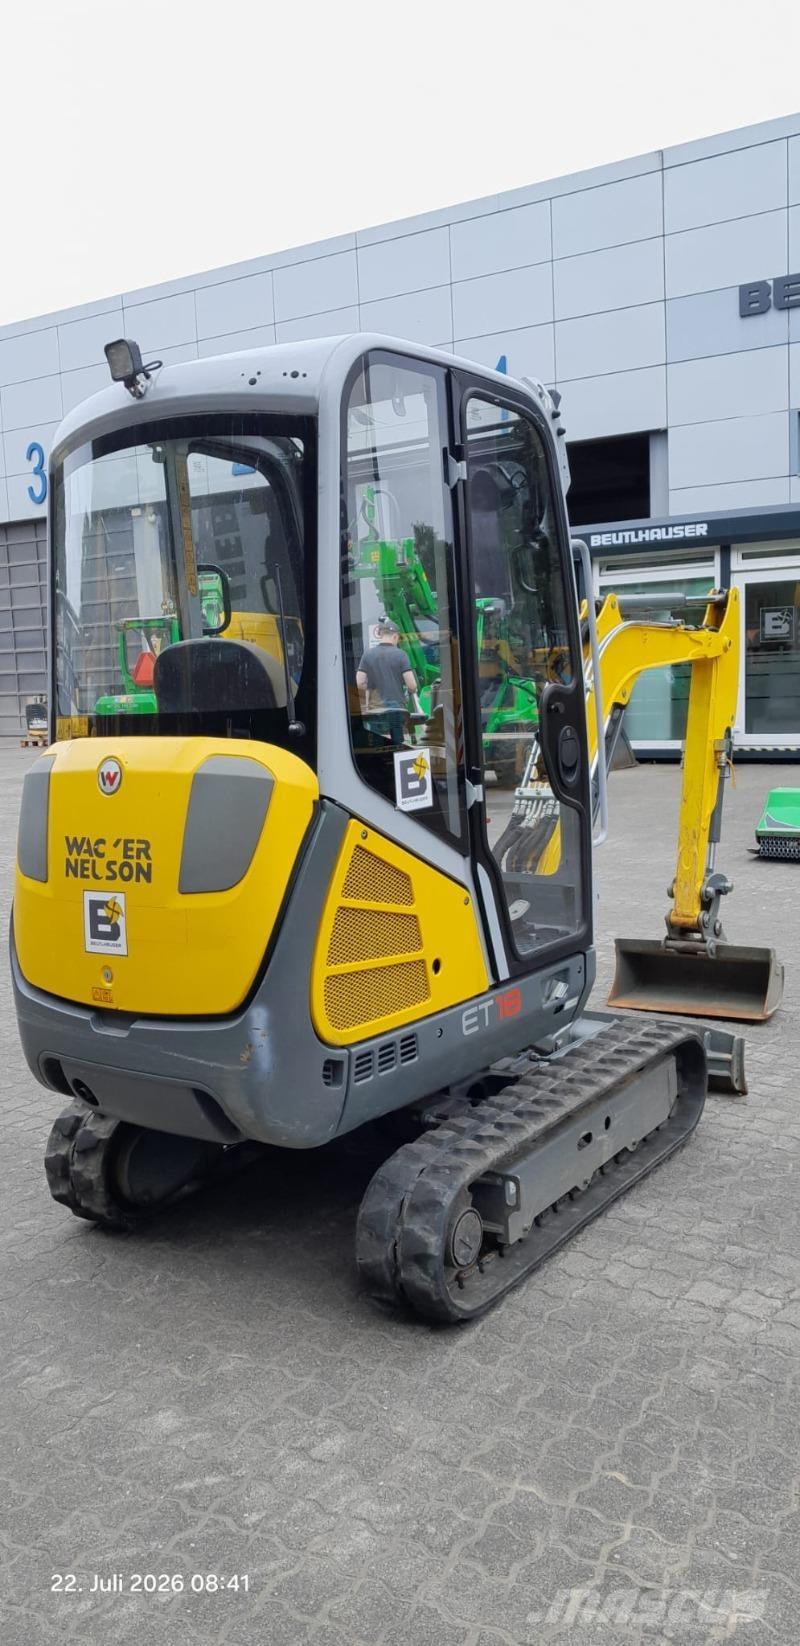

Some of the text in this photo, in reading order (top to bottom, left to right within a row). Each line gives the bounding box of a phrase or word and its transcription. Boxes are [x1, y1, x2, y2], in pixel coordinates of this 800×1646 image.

[26, 442, 48, 505] 3
[590, 523, 708, 547] BEUTLHAUSER
[64, 836, 152, 861] WACER
[65, 858, 152, 884] NELSON
